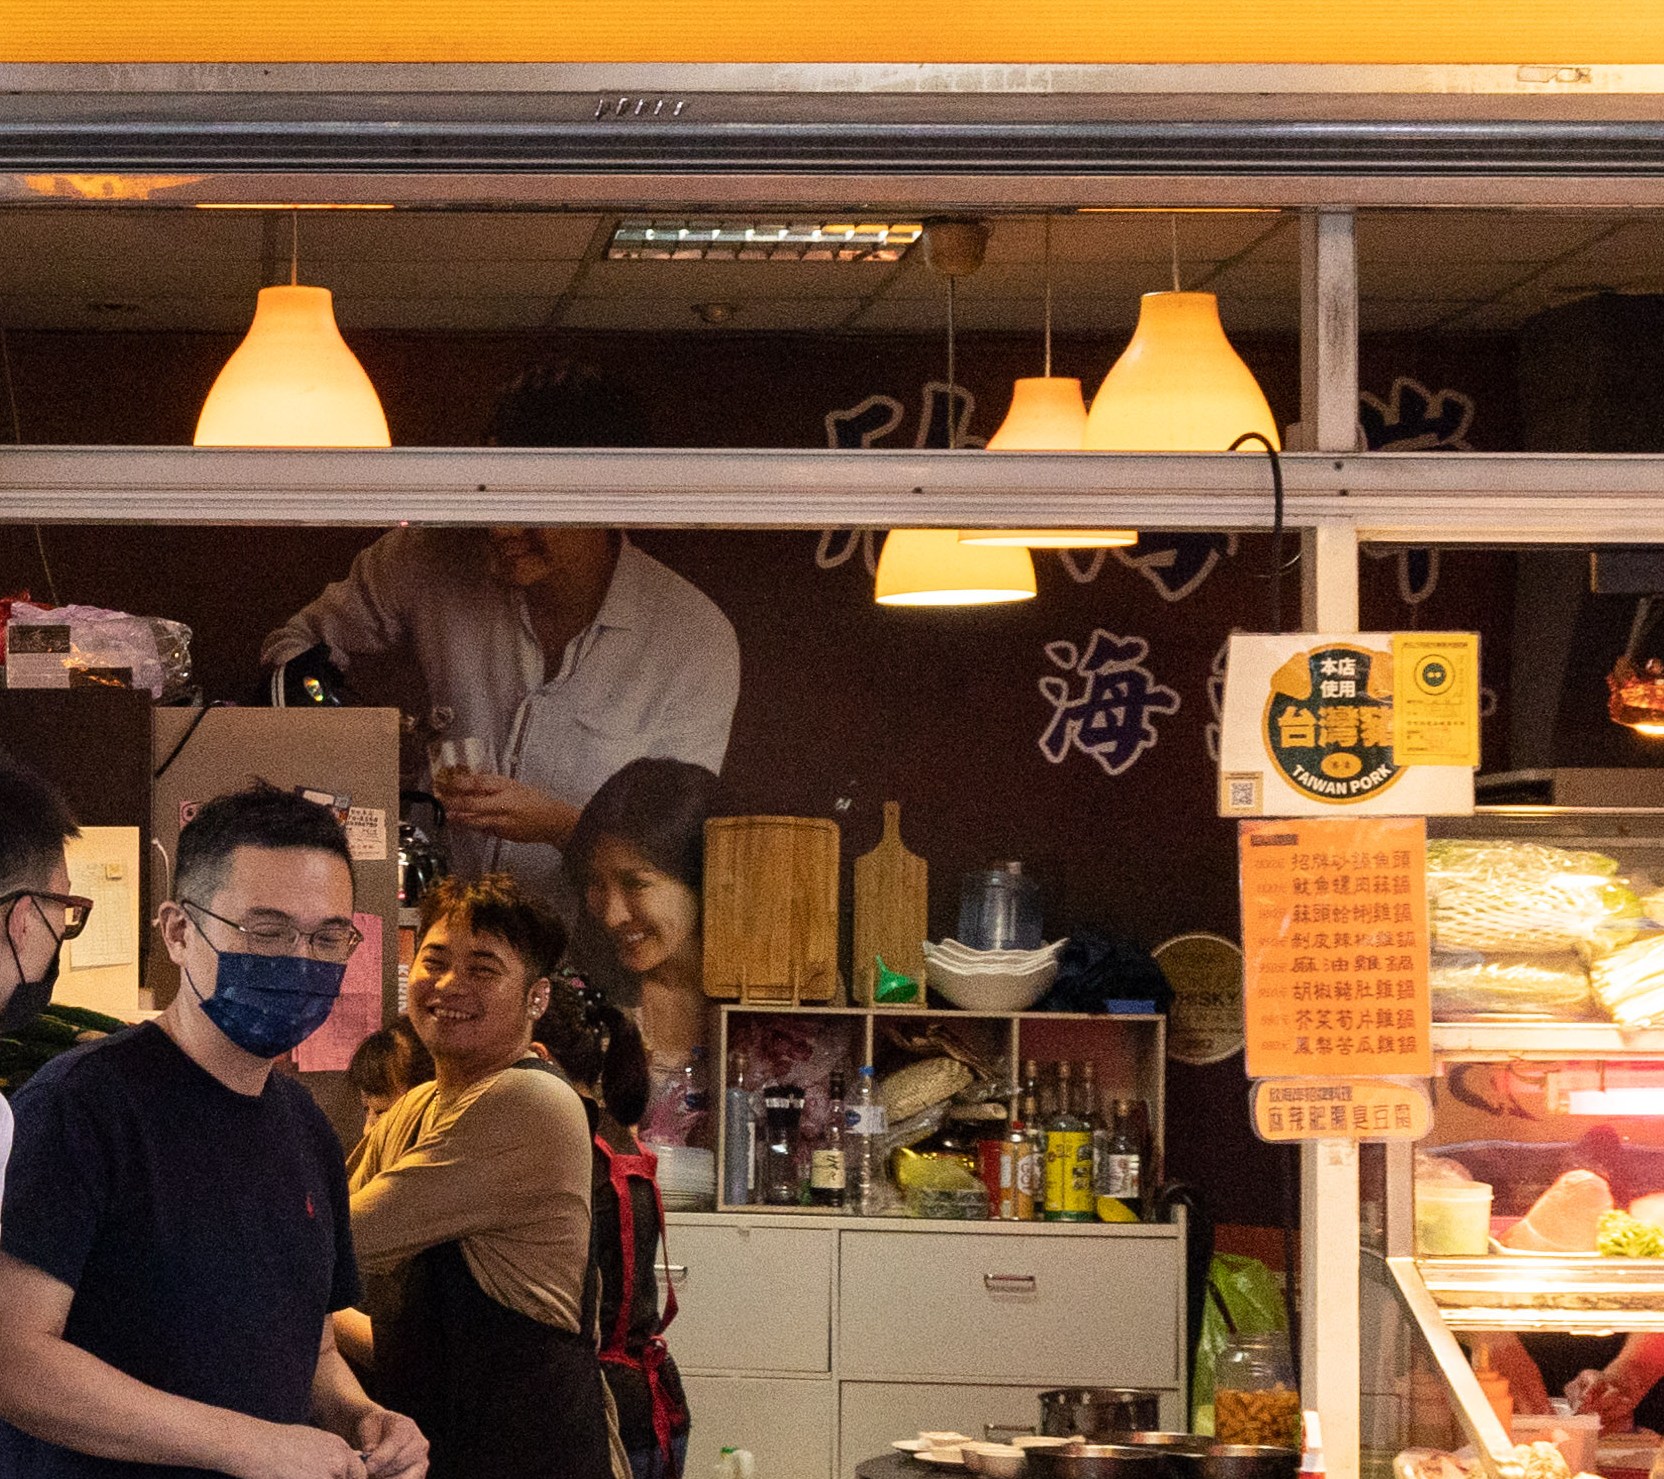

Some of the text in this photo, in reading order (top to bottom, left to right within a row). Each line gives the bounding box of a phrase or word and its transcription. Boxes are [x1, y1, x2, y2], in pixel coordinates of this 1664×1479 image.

[1320, 656, 1356, 677] 本店
[1320, 680, 1356, 699] 使用
[1292, 763, 1393, 796] TAIWAN PORK
